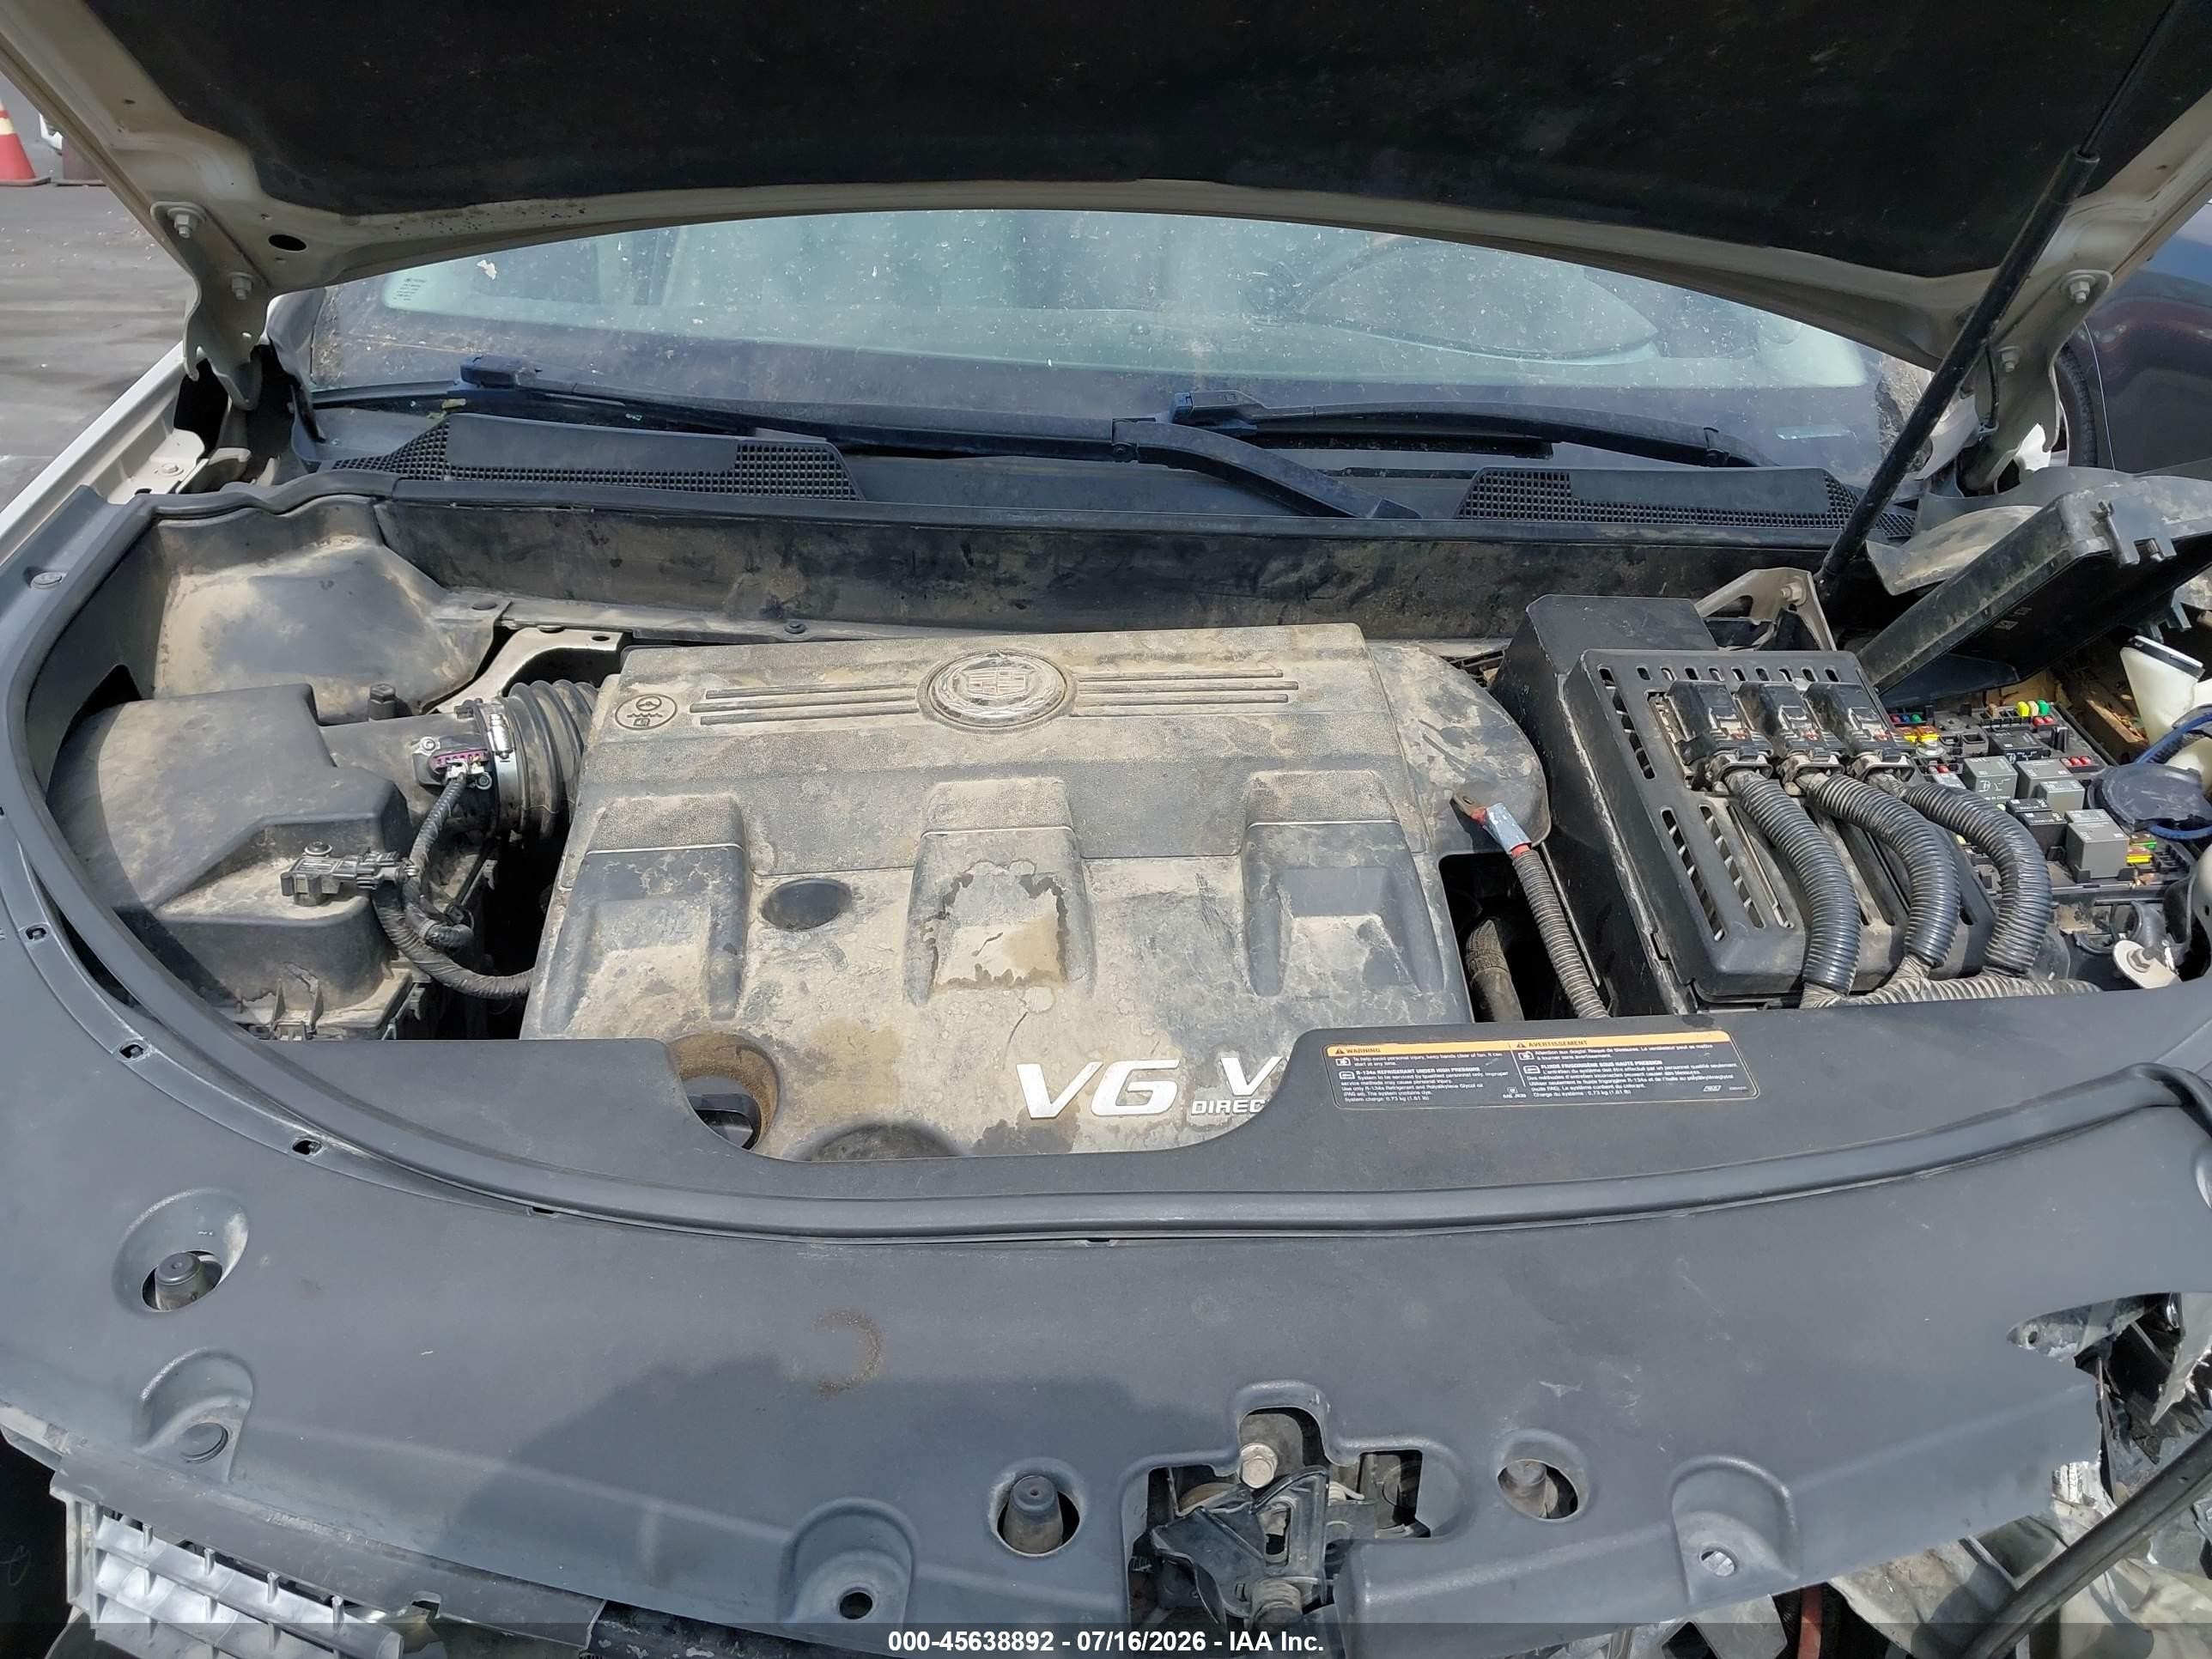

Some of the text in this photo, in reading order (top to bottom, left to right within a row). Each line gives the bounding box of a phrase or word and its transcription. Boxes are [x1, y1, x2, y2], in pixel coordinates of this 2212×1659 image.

[1016, 1056, 1290, 1119] V6 V
[1191, 1099, 1272, 1115] DIREC
